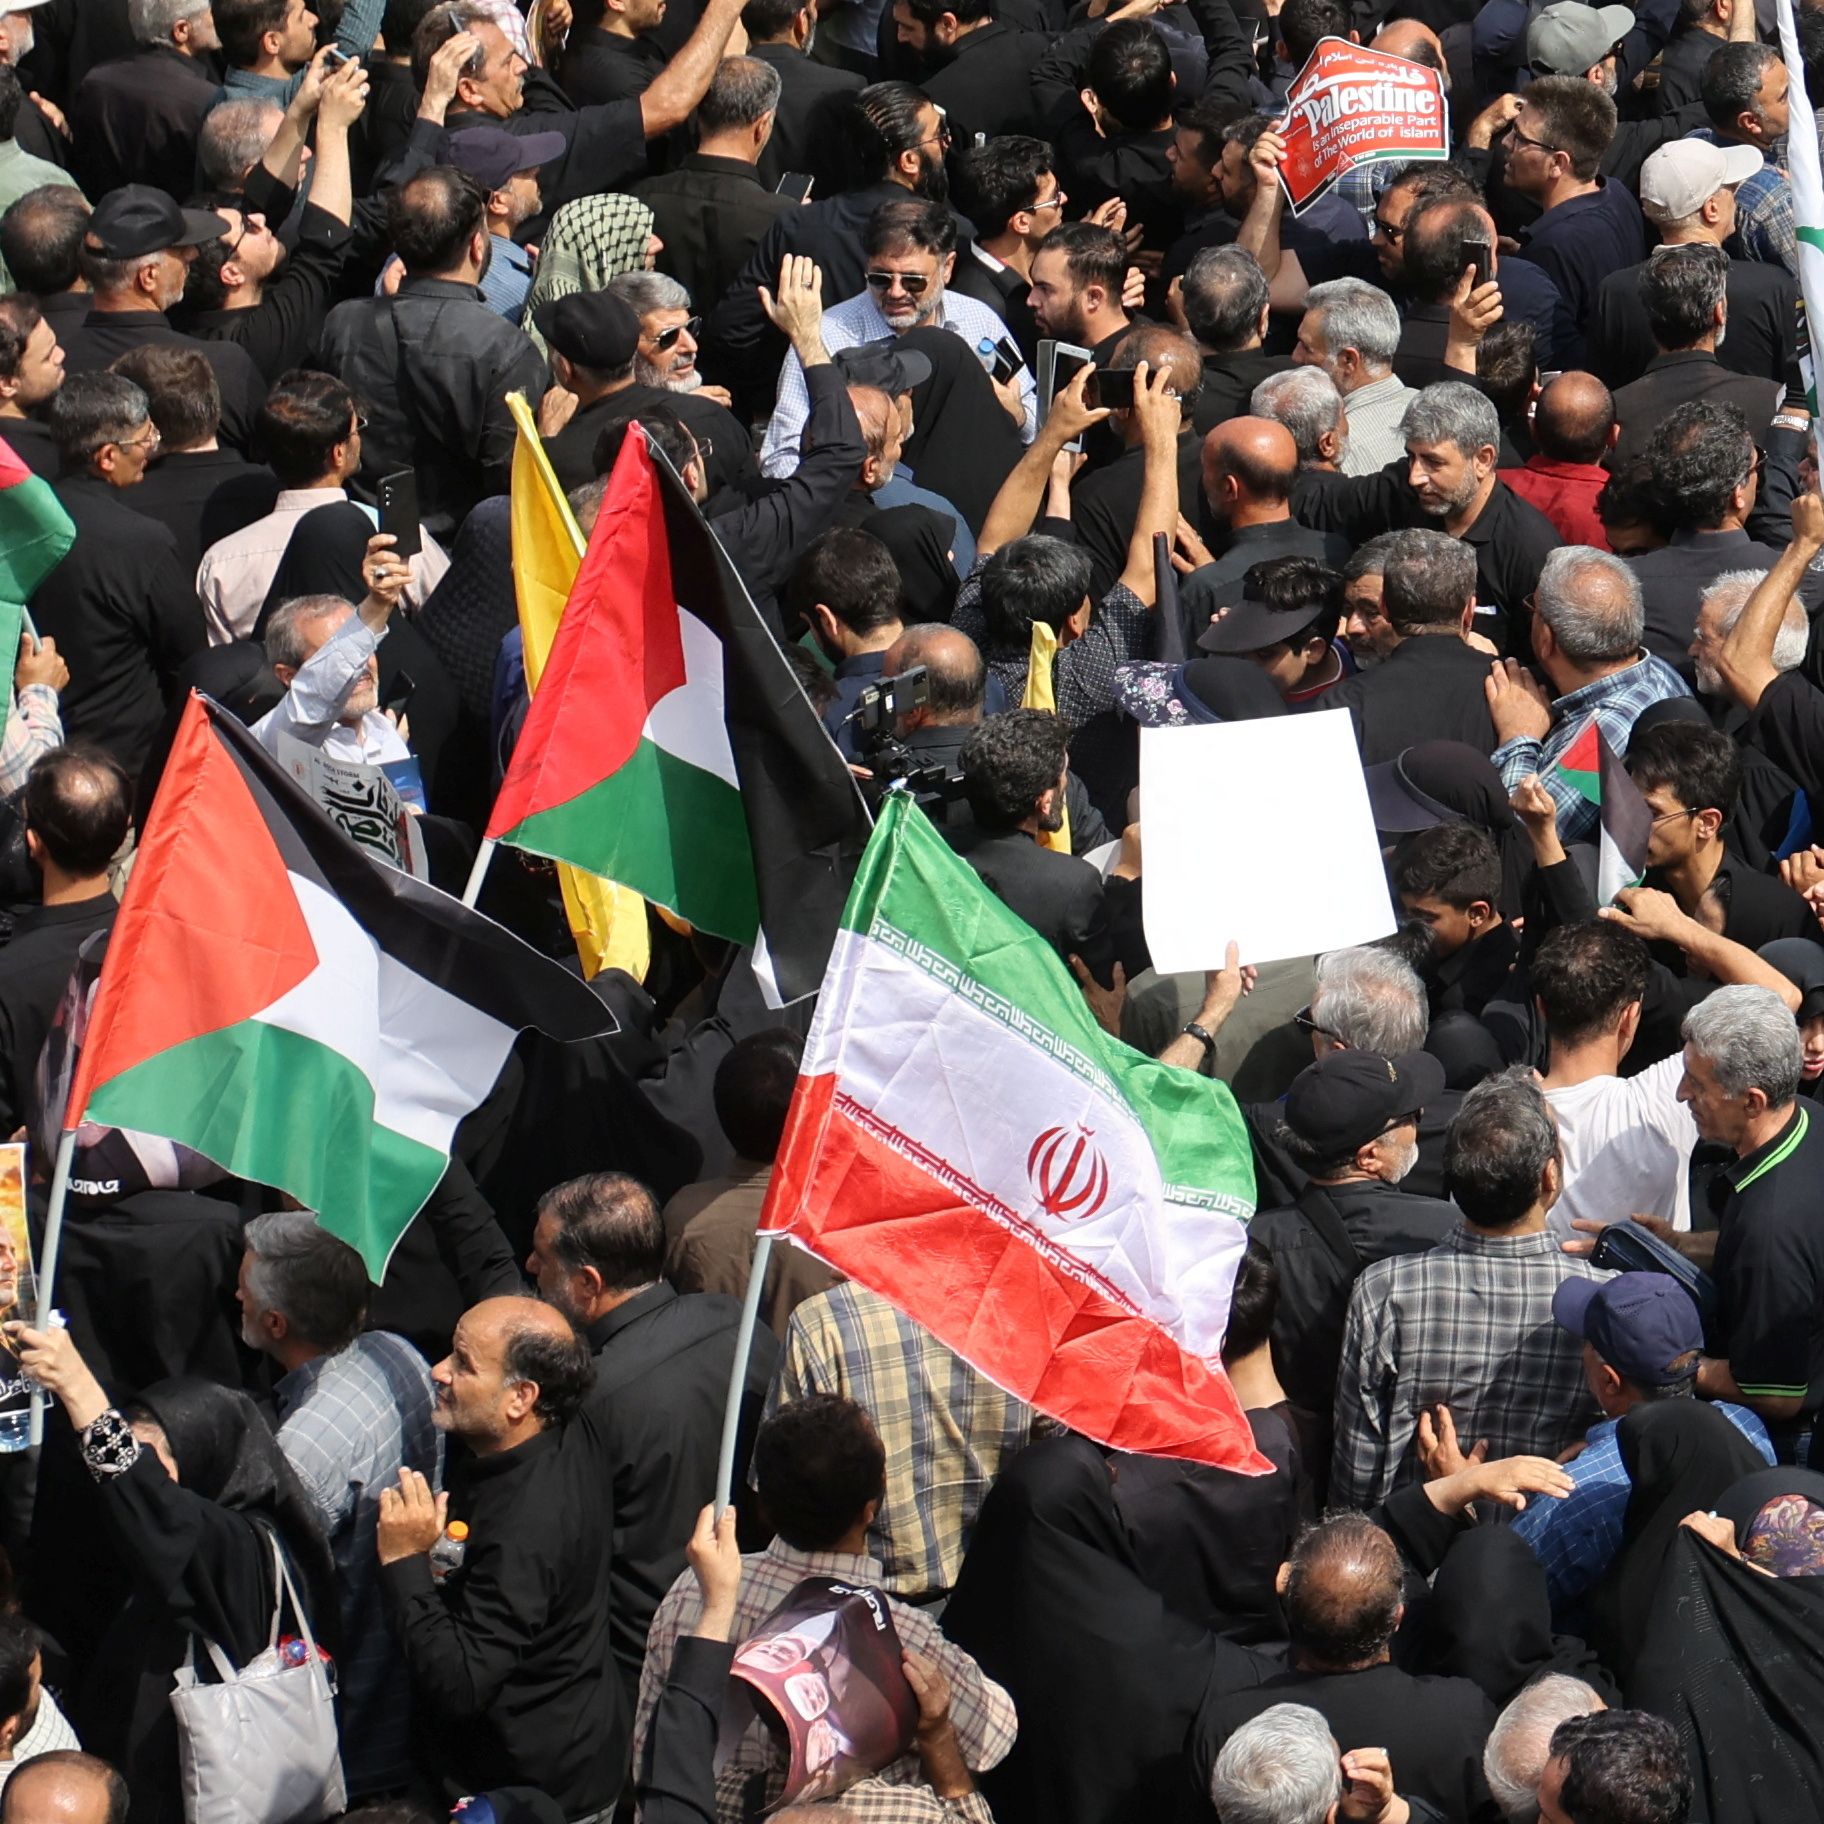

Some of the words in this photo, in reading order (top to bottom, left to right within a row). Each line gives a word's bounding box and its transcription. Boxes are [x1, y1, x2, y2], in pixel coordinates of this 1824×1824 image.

[1303, 83, 1436, 137] Palestine
[1407, 115, 1437, 126] Part
[1338, 127, 1375, 149] World
[1377, 127, 1394, 138] of
